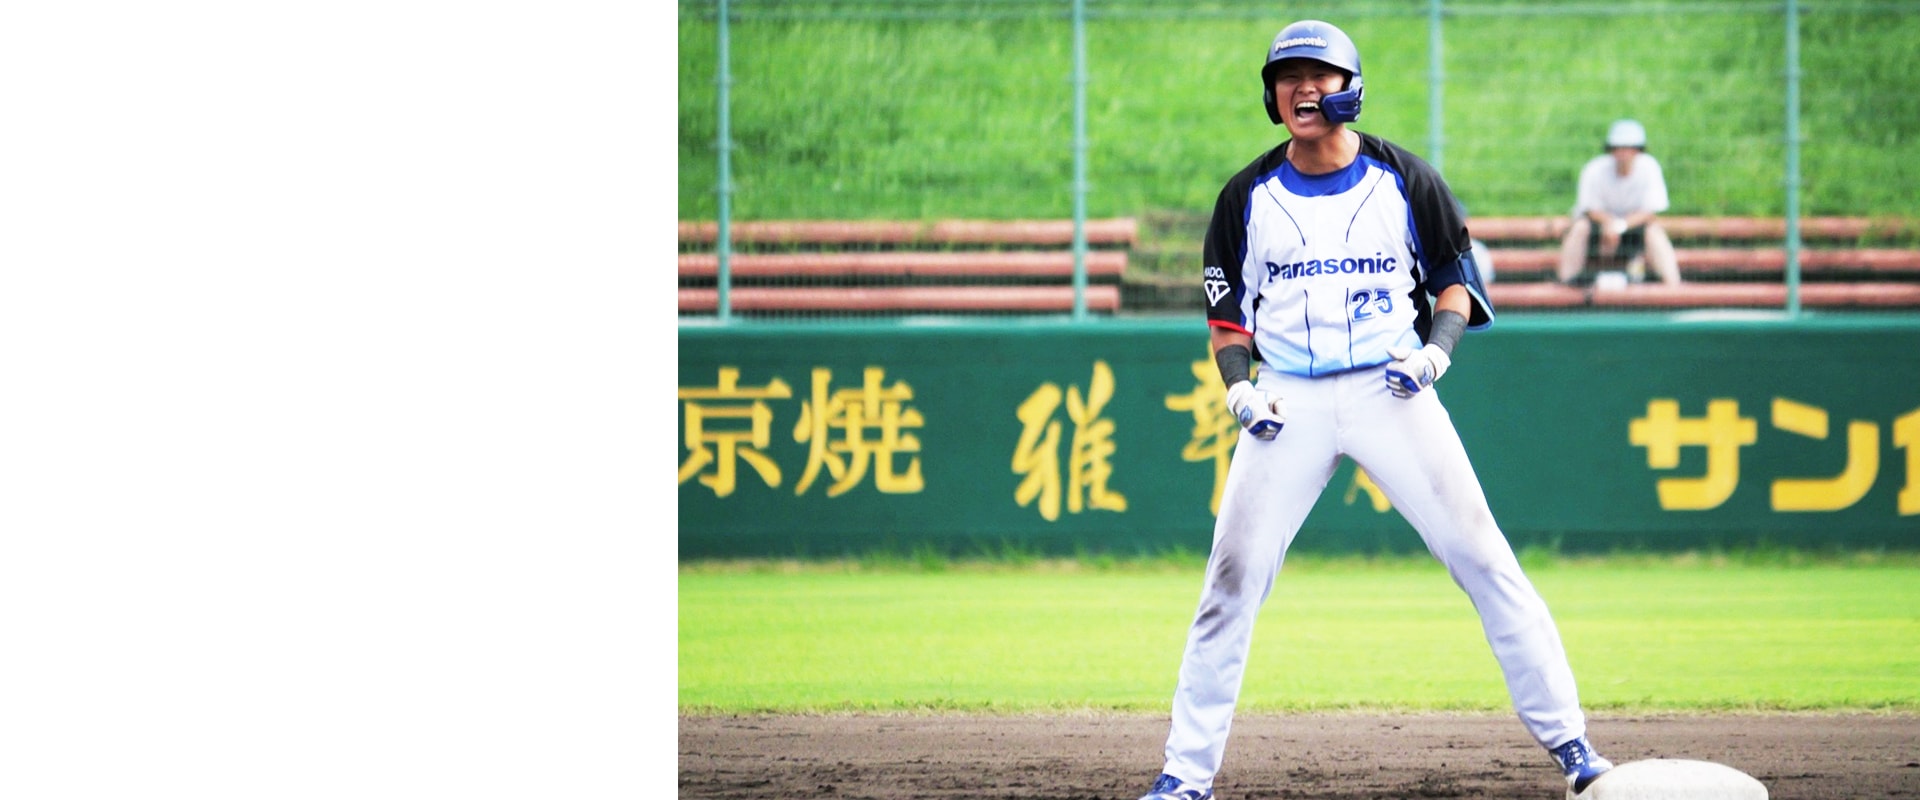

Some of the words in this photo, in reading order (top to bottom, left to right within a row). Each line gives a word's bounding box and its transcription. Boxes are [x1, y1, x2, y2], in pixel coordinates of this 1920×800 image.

[1265, 252, 1397, 283] Panasonic
[1350, 288, 1395, 322] 25
[678, 366, 925, 498] 京焼
[1629, 398, 1920, 516] サン
